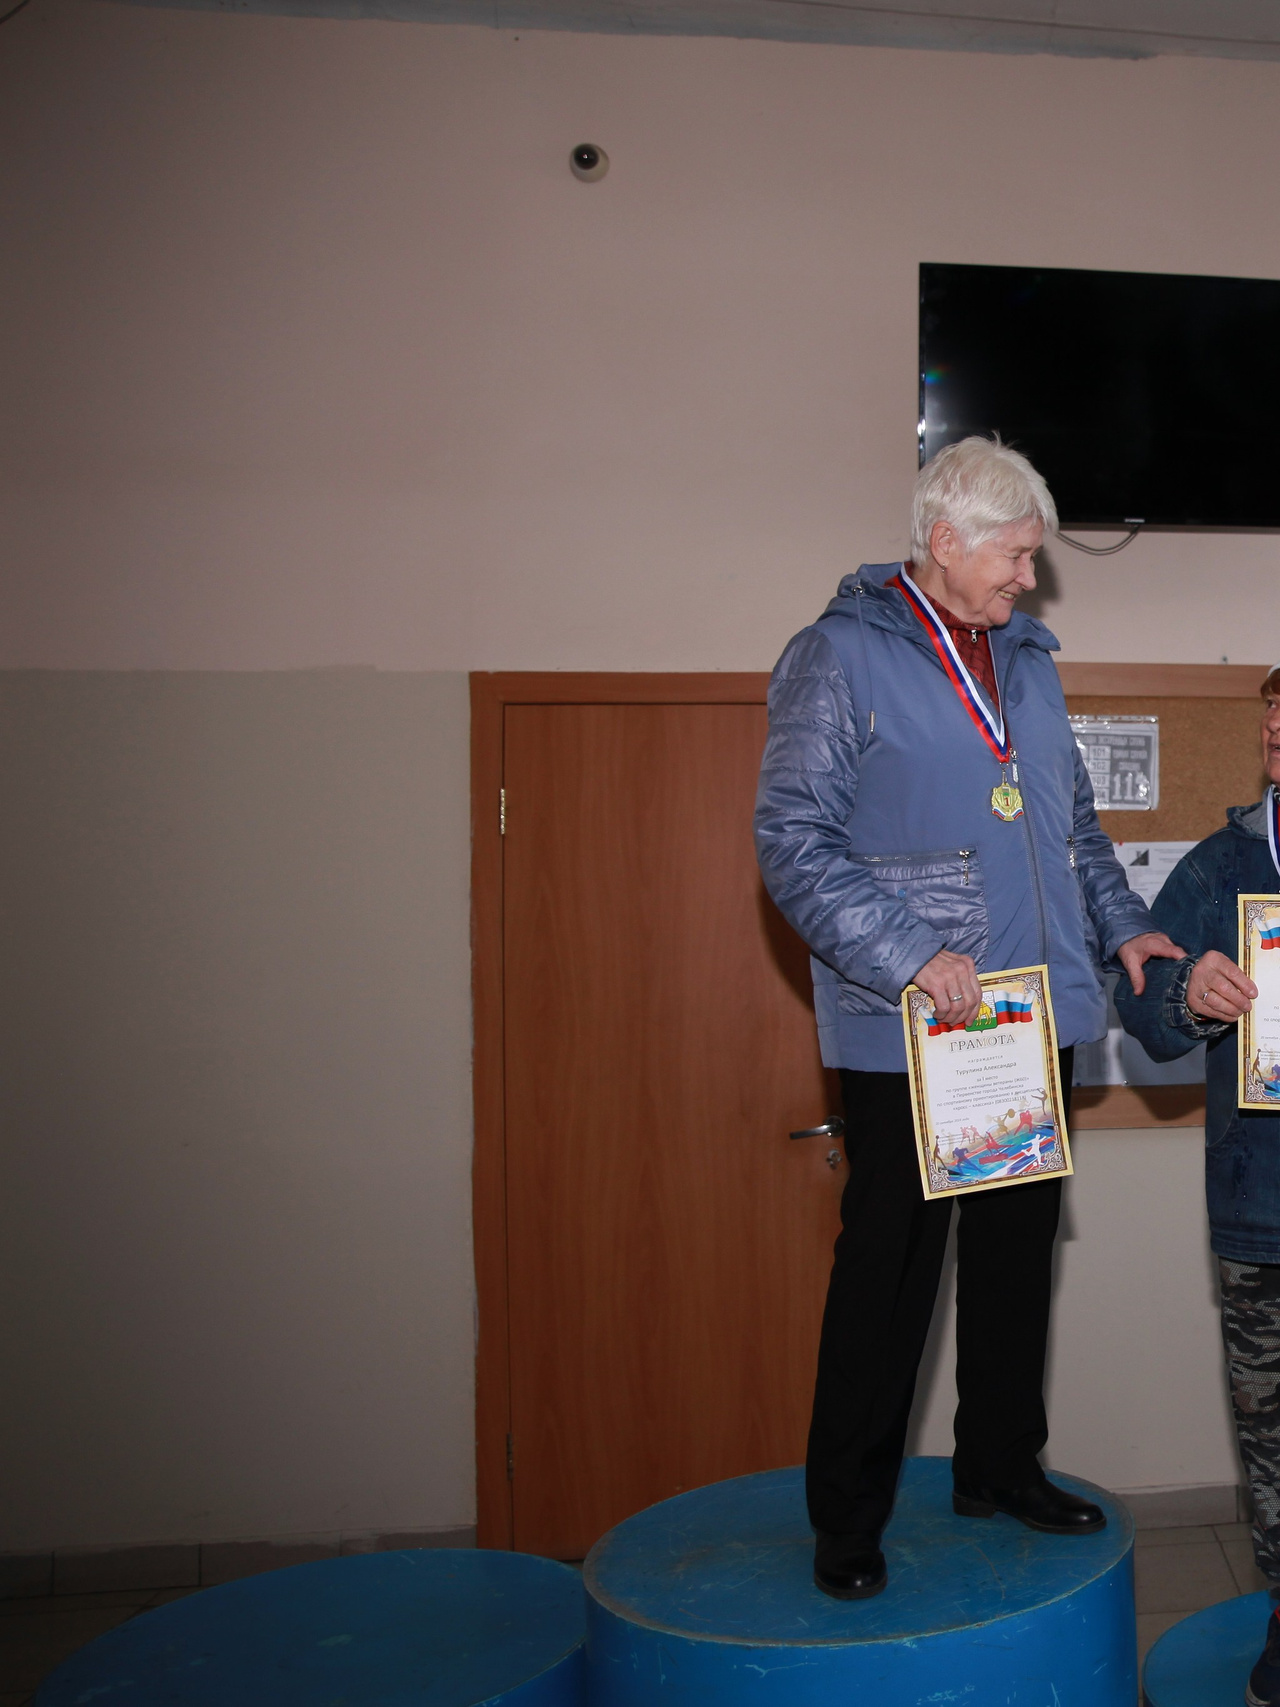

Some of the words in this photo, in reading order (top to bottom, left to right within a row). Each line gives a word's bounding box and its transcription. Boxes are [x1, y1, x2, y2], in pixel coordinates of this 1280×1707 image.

[1093, 748, 1106, 756] 101
[1093, 761, 1106, 770] 102
[1004, 797, 1010, 806] 1
[950, 1034, 1016, 1052] ГРАМОТА
[983, 1062, 1017, 1071] Александра
